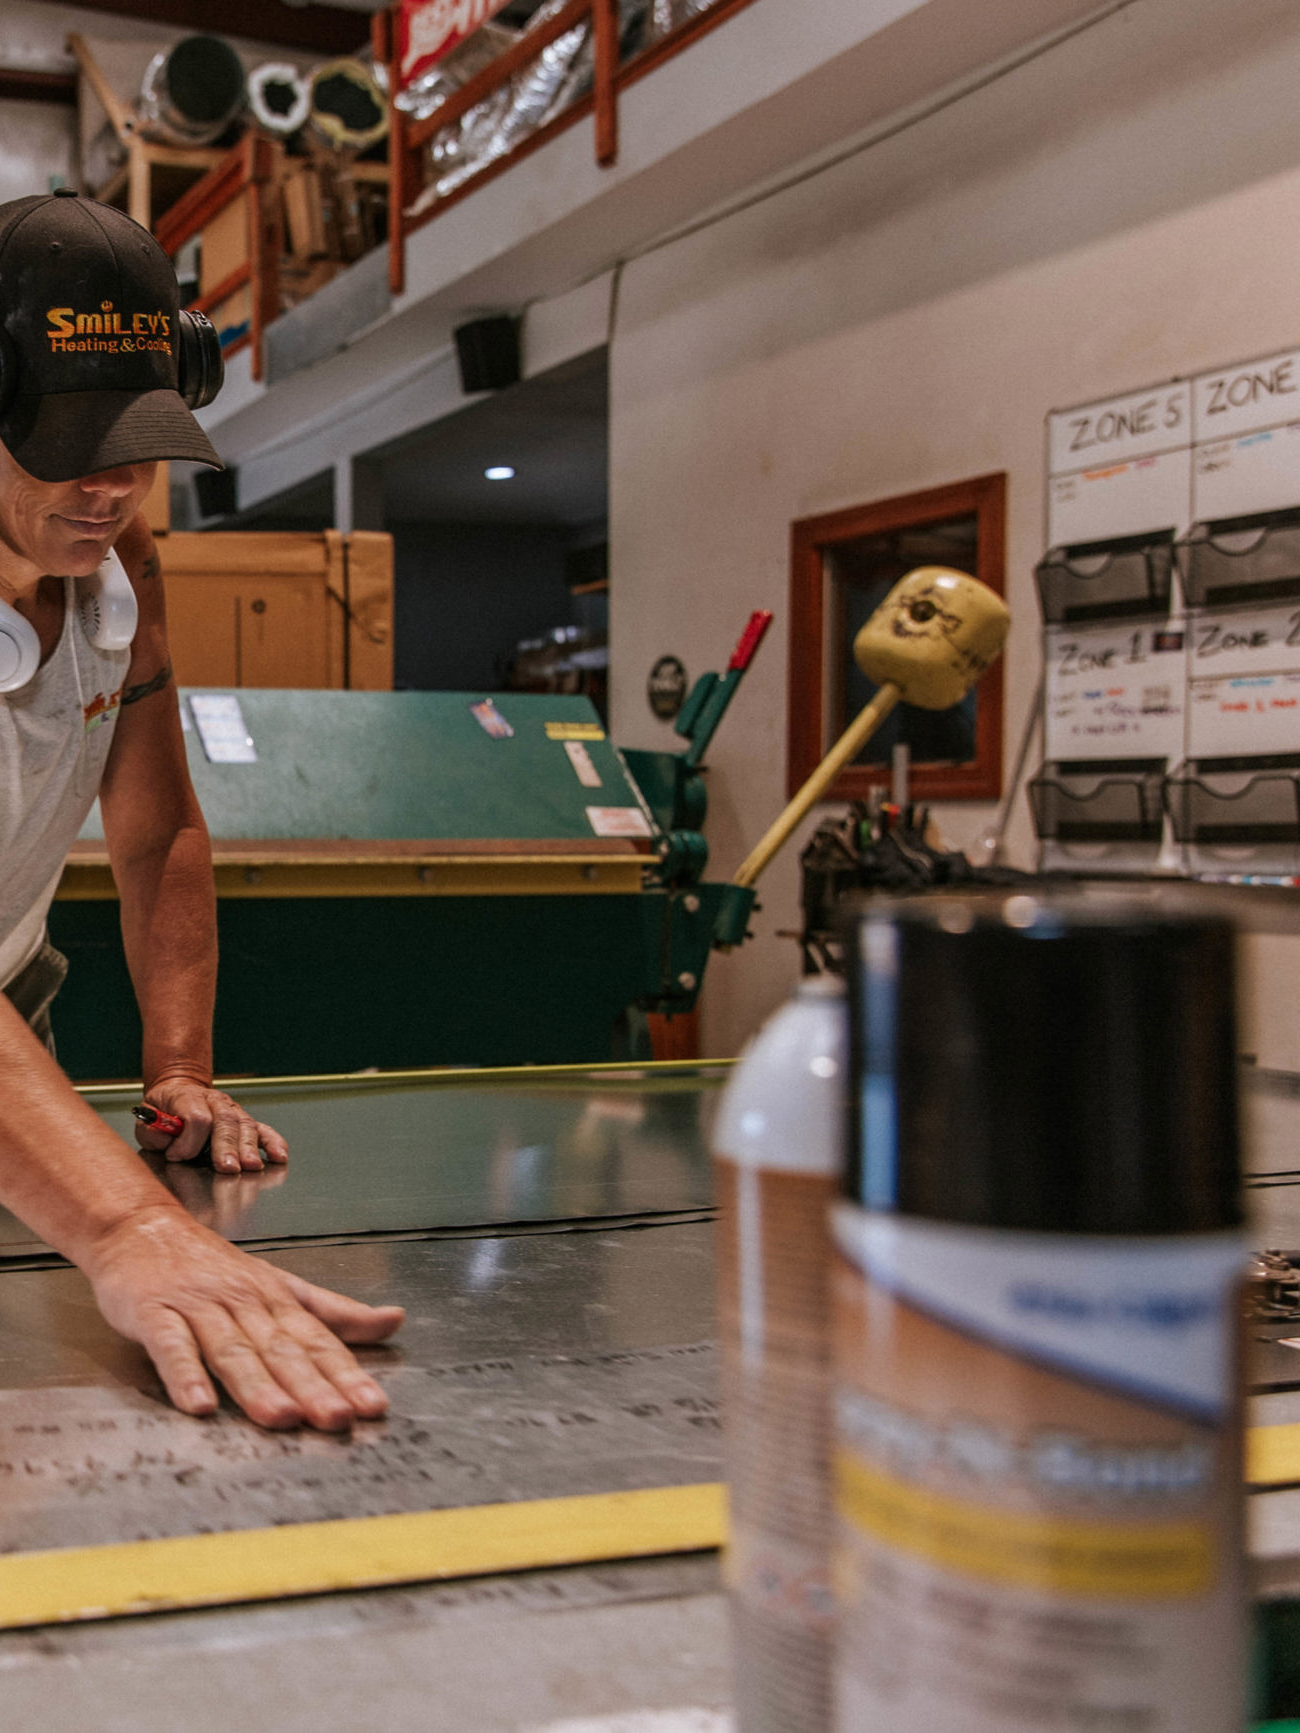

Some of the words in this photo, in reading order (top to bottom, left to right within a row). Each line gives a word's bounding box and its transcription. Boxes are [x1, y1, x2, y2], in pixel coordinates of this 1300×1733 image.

[1206, 358, 1299, 417] ZONE
[1068, 398, 1157, 453] ZONE
[1164, 390, 1184, 429] 5
[1124, 630, 1147, 666] 1
